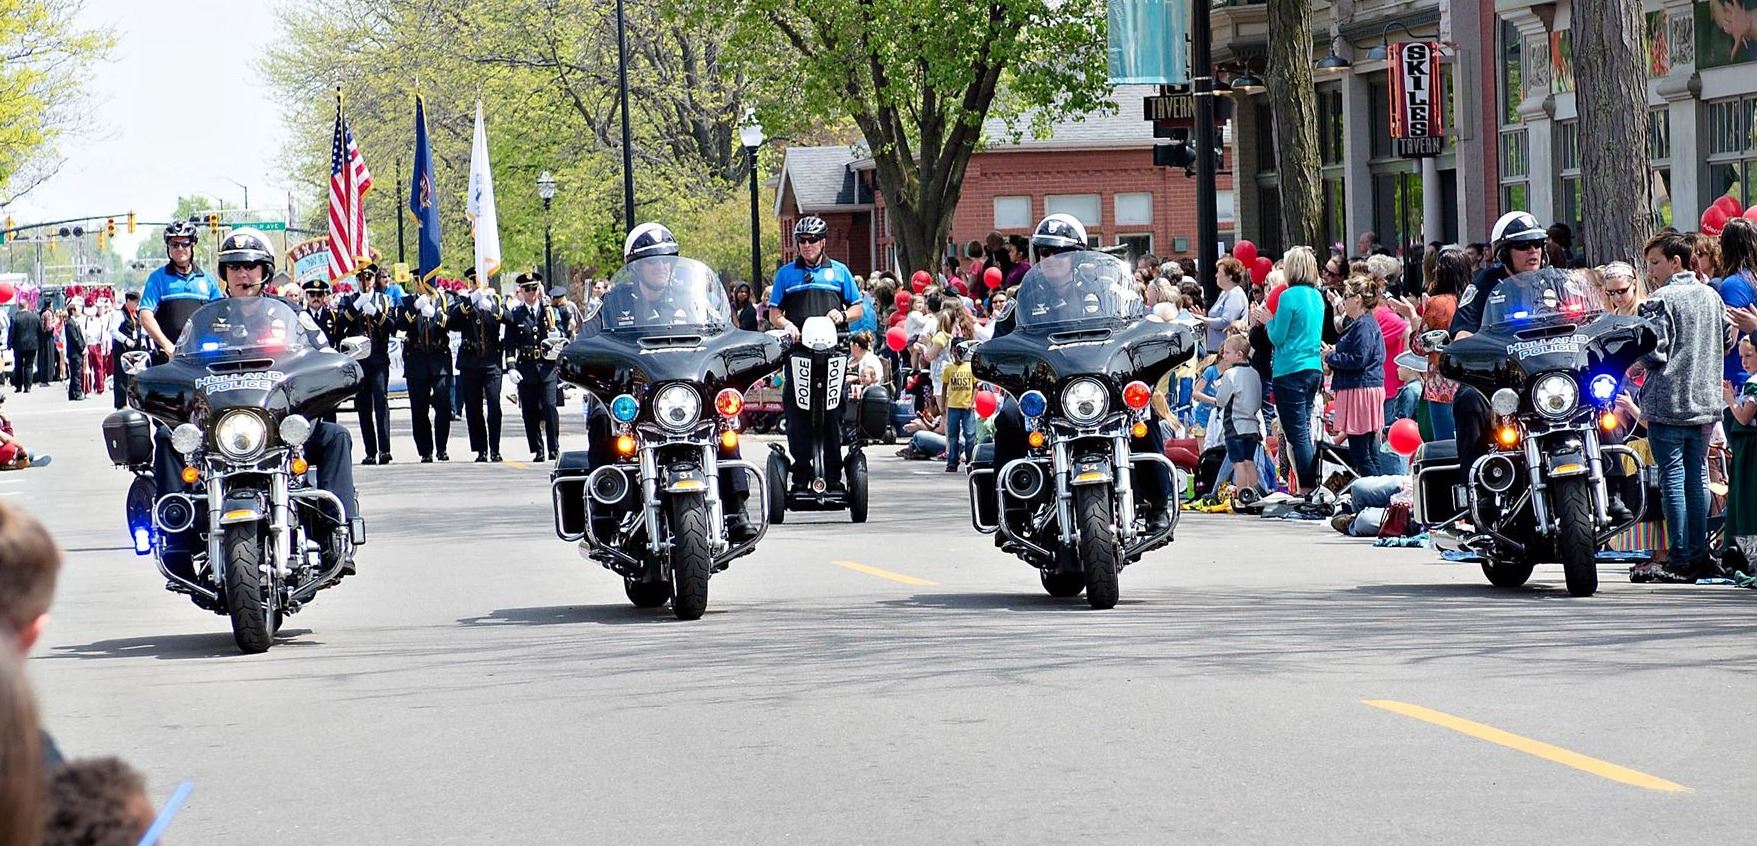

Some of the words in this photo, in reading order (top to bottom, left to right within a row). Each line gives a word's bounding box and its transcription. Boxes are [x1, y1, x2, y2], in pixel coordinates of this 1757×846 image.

[1405, 45, 1429, 136] SKILES
[1150, 96, 1195, 119] TAVERN
[1400, 137, 1441, 154] TAVERN
[1702, 223, 1722, 235] Adecc
[1507, 335, 1588, 355] HOLLAND
[1519, 344, 1579, 360] POLICE
[195, 371, 284, 389] HOLLAND
[206, 381, 272, 395] POLICE
[798, 360, 810, 406] POLICE
[828, 360, 839, 406] POLICE
[950, 377, 971, 386] MOST
